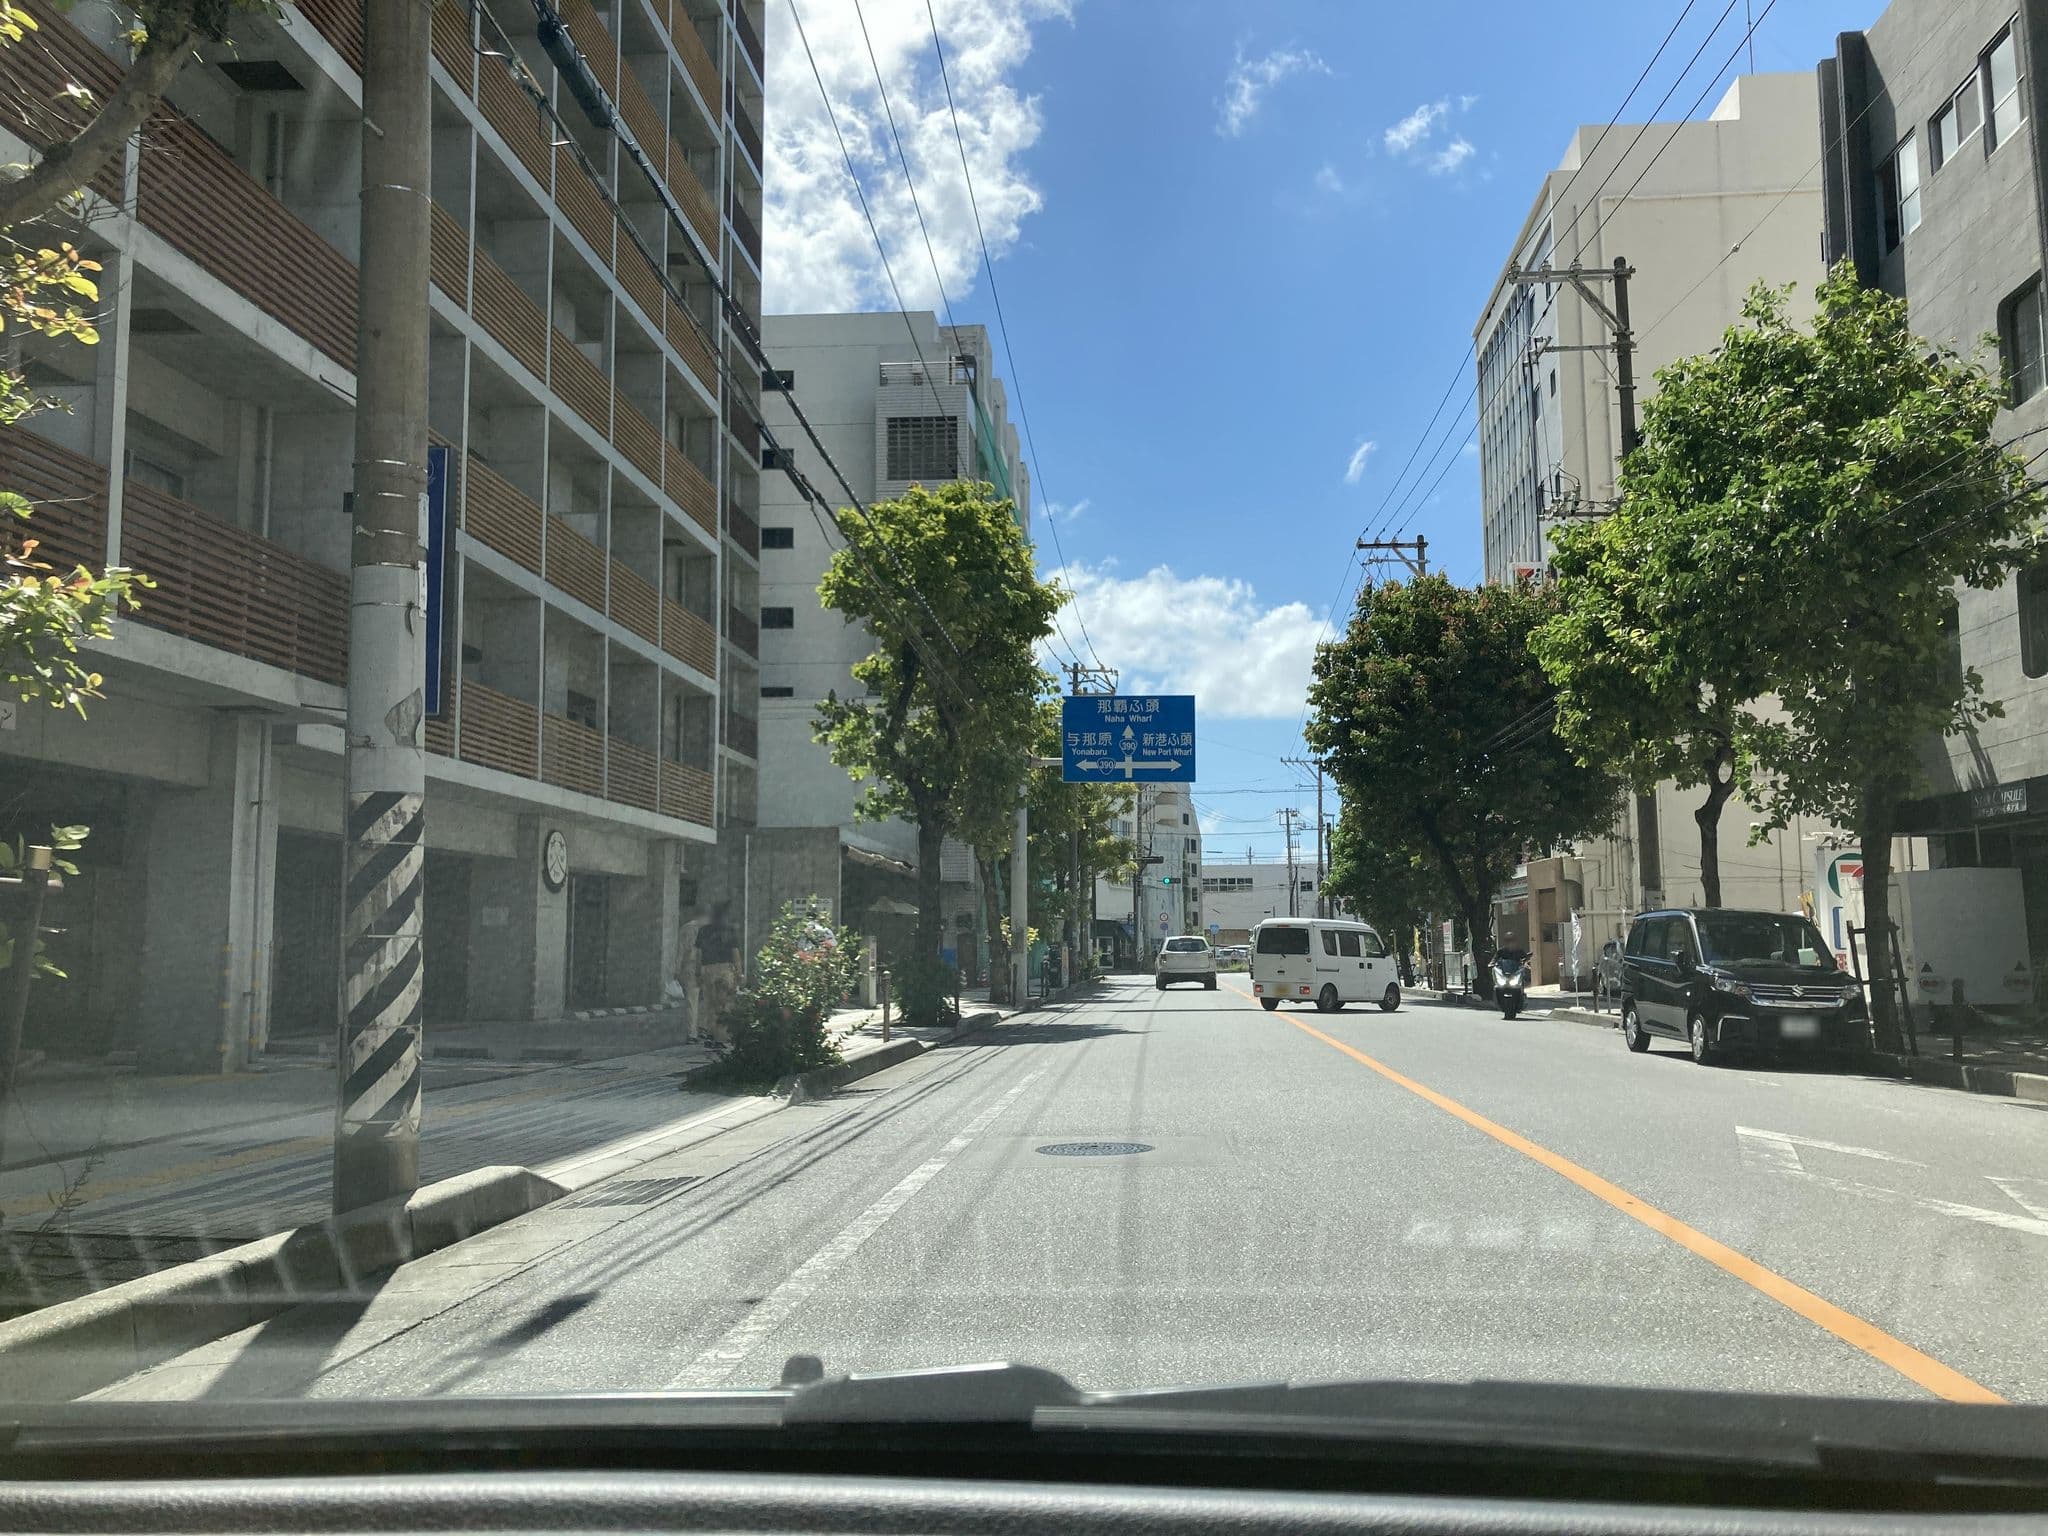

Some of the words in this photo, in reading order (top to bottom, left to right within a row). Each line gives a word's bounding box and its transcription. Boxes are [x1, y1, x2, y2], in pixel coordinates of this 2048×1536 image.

[1097, 698, 1160, 713] 那覇ふ頭
[1104, 714, 1125, 723] Naha
[1129, 714, 1153, 723] Wharf
[1067, 732, 1113, 746] 与那原
[1142, 732, 1193, 747] 新港ふ頭
[1121, 741, 1137, 751] 390
[1071, 748, 1108, 756] Yonabaru
[1142, 748, 1157, 756] New
[1159, 748, 1172, 756] Port
[1174, 748, 1193, 756] Wharf
[1099, 760, 1115, 770] 390
